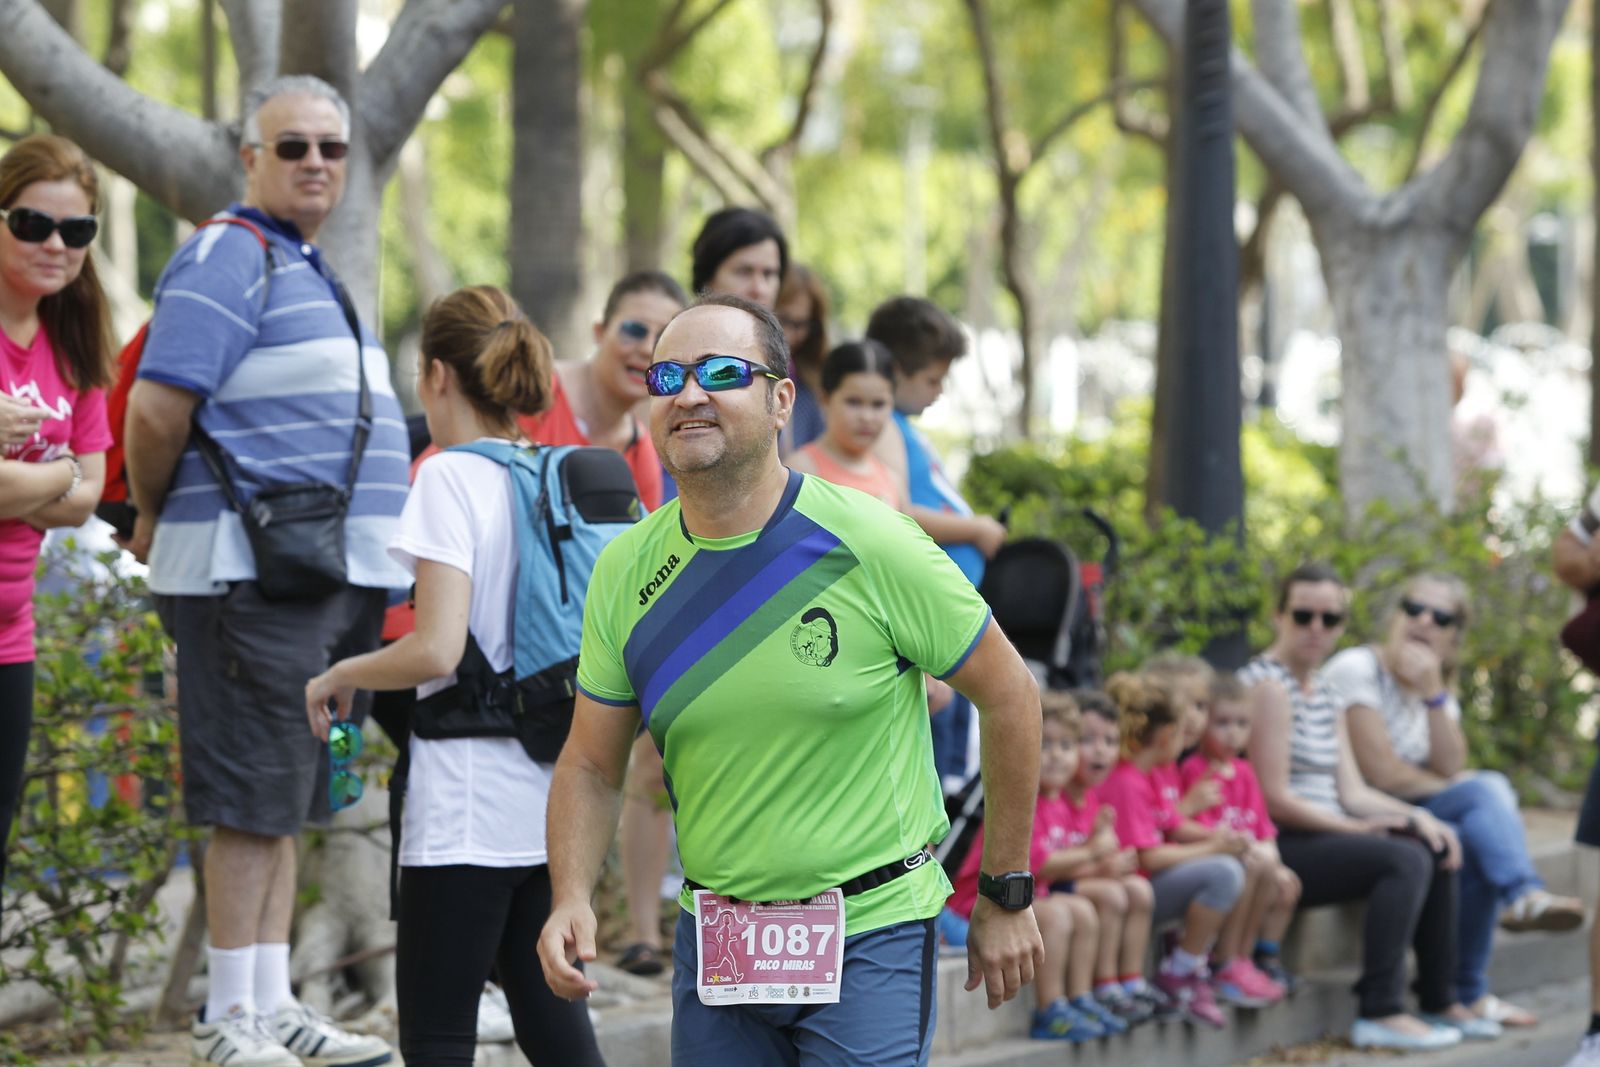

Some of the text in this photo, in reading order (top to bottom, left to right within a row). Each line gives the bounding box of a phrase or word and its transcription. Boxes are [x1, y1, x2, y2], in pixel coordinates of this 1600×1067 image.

[638, 554, 681, 606] Joma
[741, 924, 835, 956] 1087
[753, 960, 815, 971] PACO MIRAS
